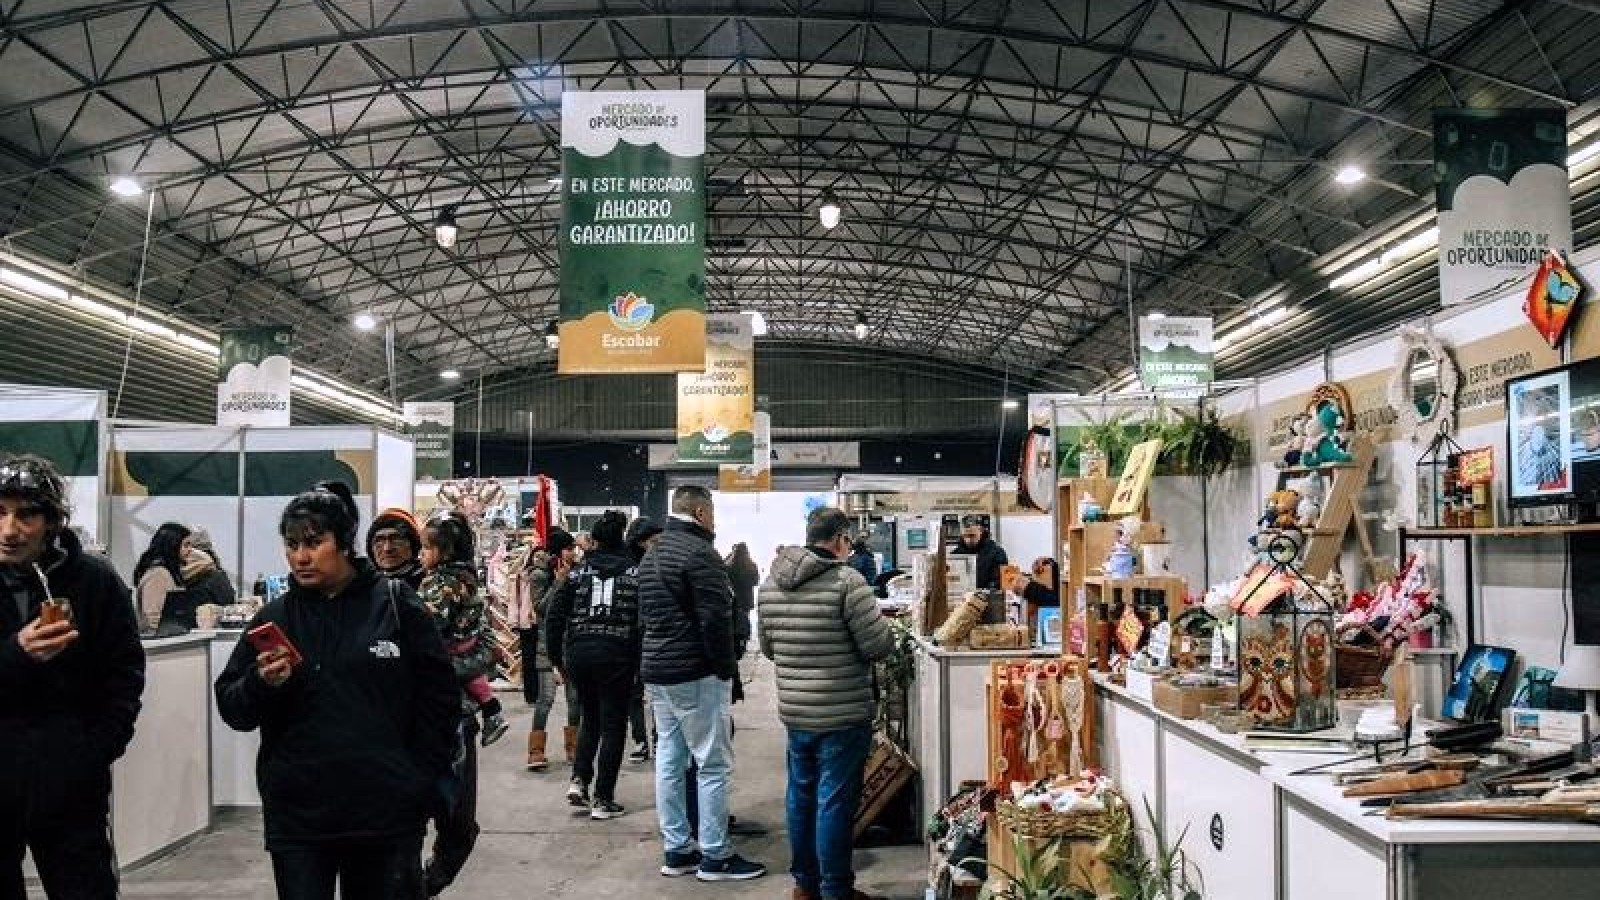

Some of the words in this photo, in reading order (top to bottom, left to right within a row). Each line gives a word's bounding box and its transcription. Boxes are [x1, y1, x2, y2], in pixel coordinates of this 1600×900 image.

[589, 115, 678, 129] OPORTUNIDADES
[571, 177, 588, 193] EN
[592, 177, 625, 193] ESTE
[594, 199, 672, 222] ¡AHORRO
[569, 222, 695, 244] GARANTIZADO!
[1463, 229, 1532, 247] MERCADO
[601, 333, 661, 349] Escobar
